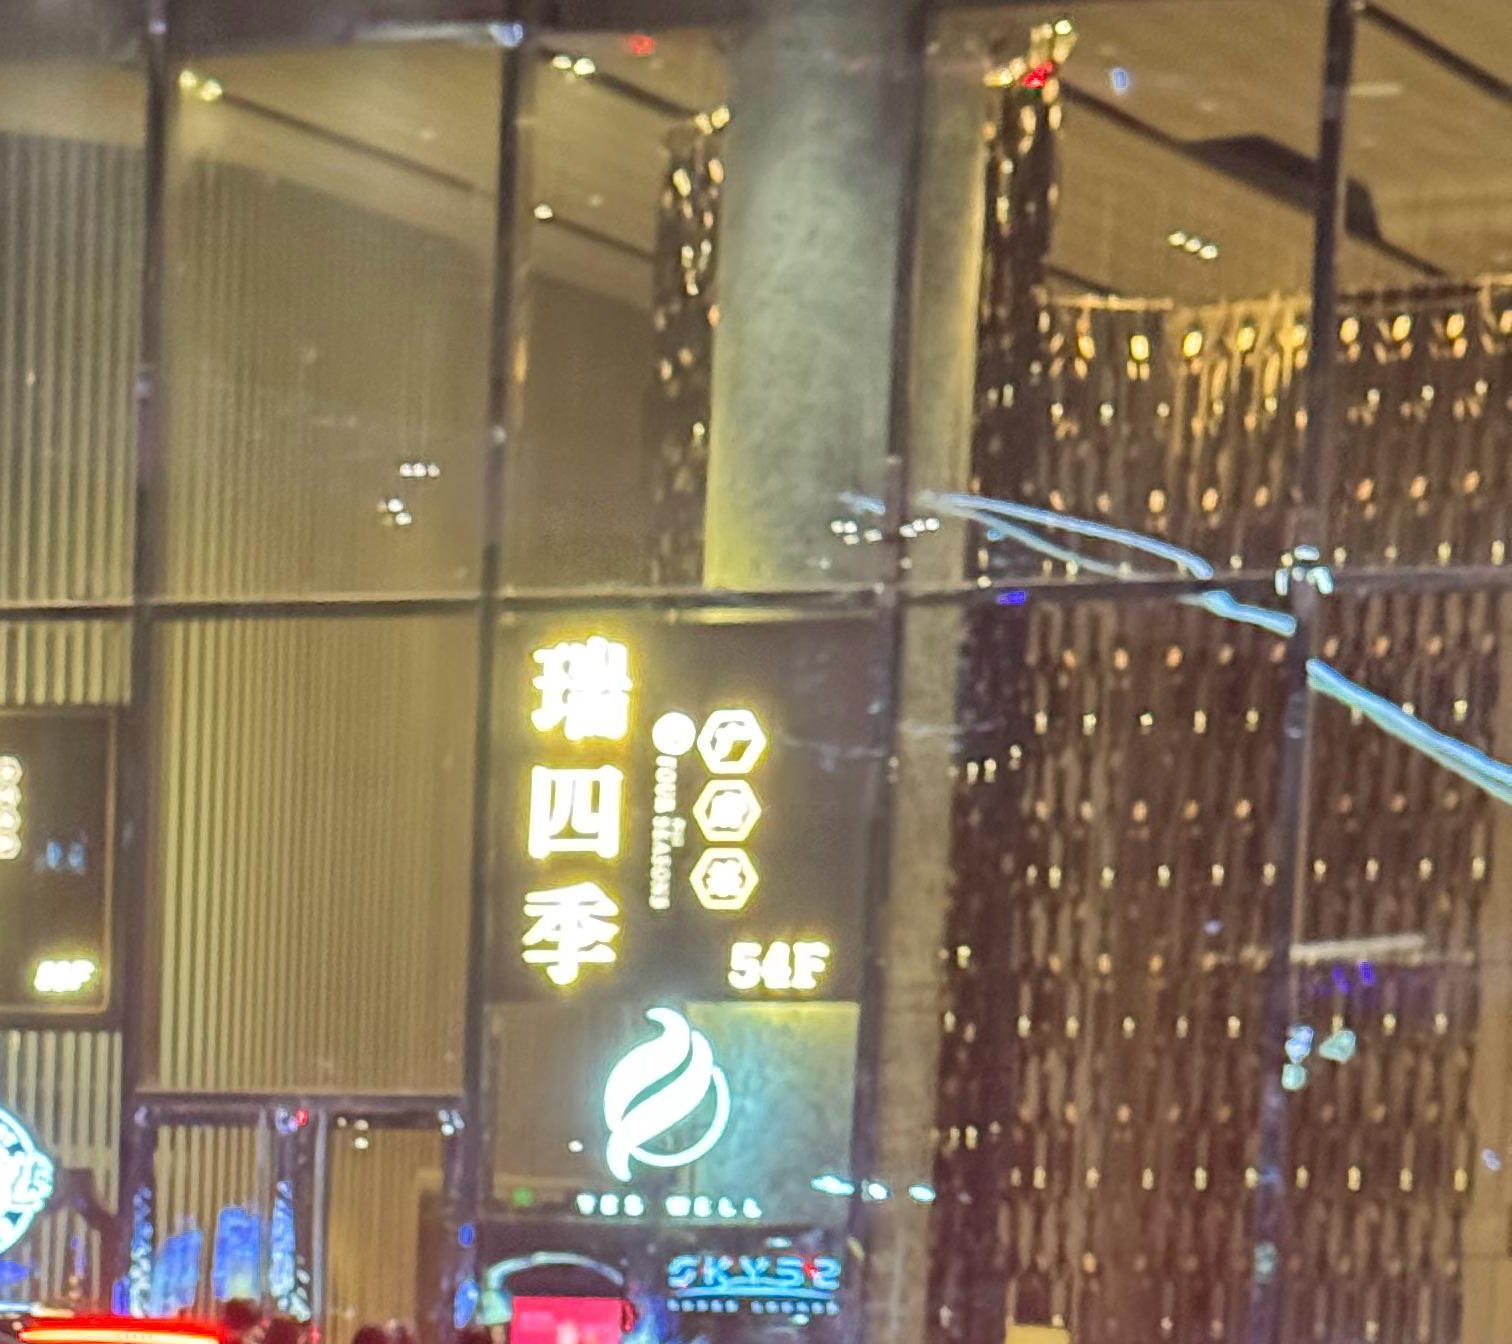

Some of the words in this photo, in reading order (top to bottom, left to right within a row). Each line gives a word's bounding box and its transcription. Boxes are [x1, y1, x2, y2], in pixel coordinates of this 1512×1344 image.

[522, 636, 633, 985] 瑞四季
[728, 941, 831, 990] 54F
[667, 1255, 841, 1290] SKY52
